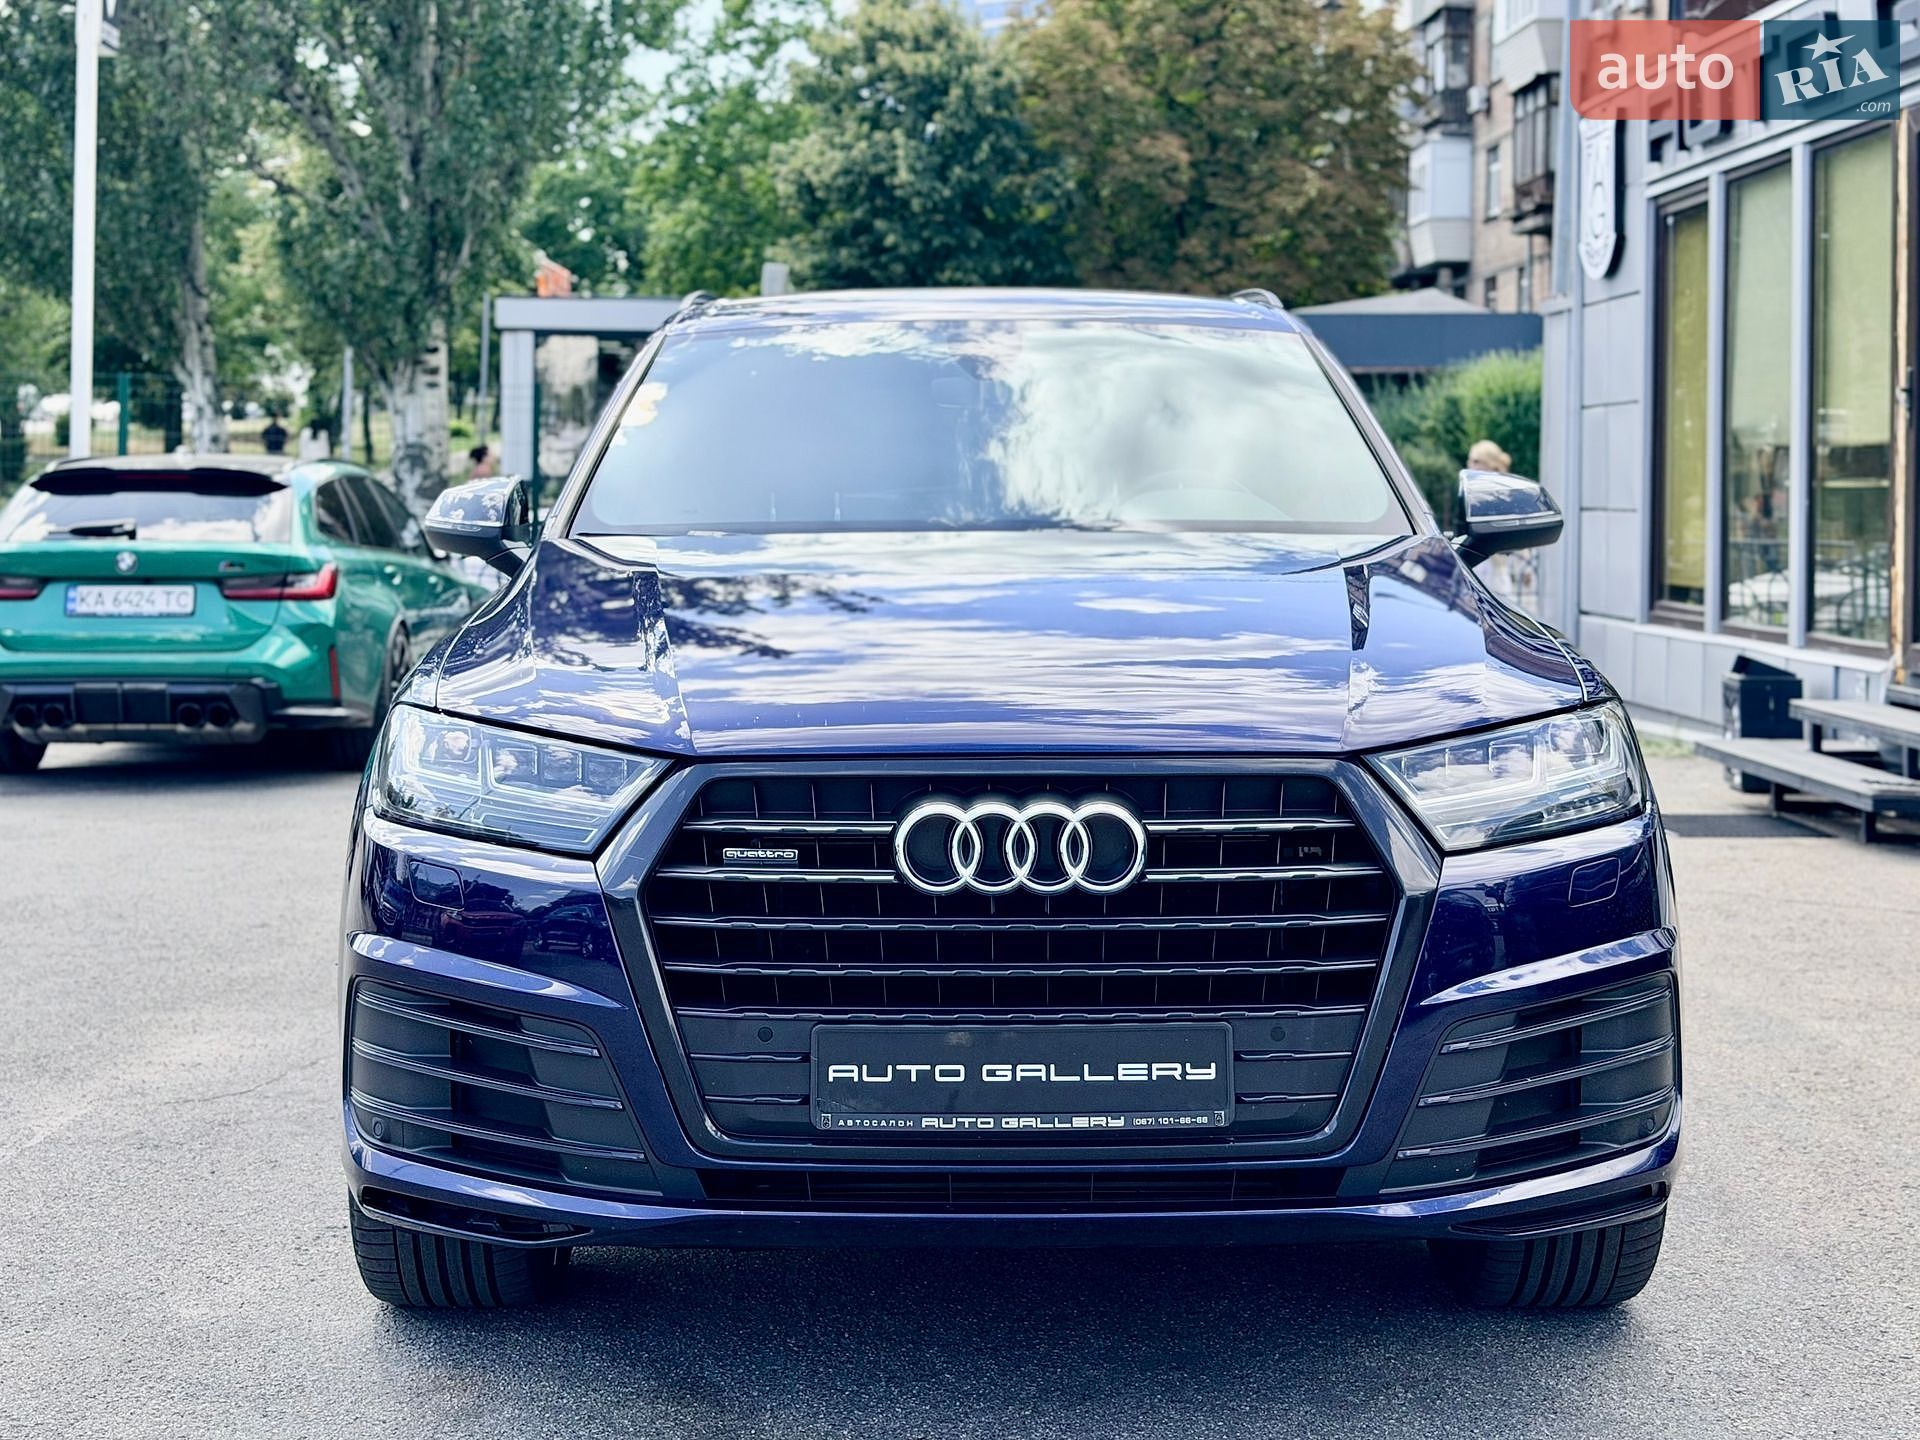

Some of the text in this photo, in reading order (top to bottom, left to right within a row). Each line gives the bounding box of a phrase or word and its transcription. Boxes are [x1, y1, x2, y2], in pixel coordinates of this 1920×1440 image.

[79, 591, 105, 608] KA
[112, 591, 156, 608] 6424
[163, 591, 190, 608] TC
[726, 850, 795, 859] quattro
[827, 1062, 1217, 1083] AUTO GALLERY
[837, 1119, 914, 1127] АВТОСАЛОН
[921, 1117, 994, 1129] AUTO
[1001, 1116, 1125, 1129] GALLERY
